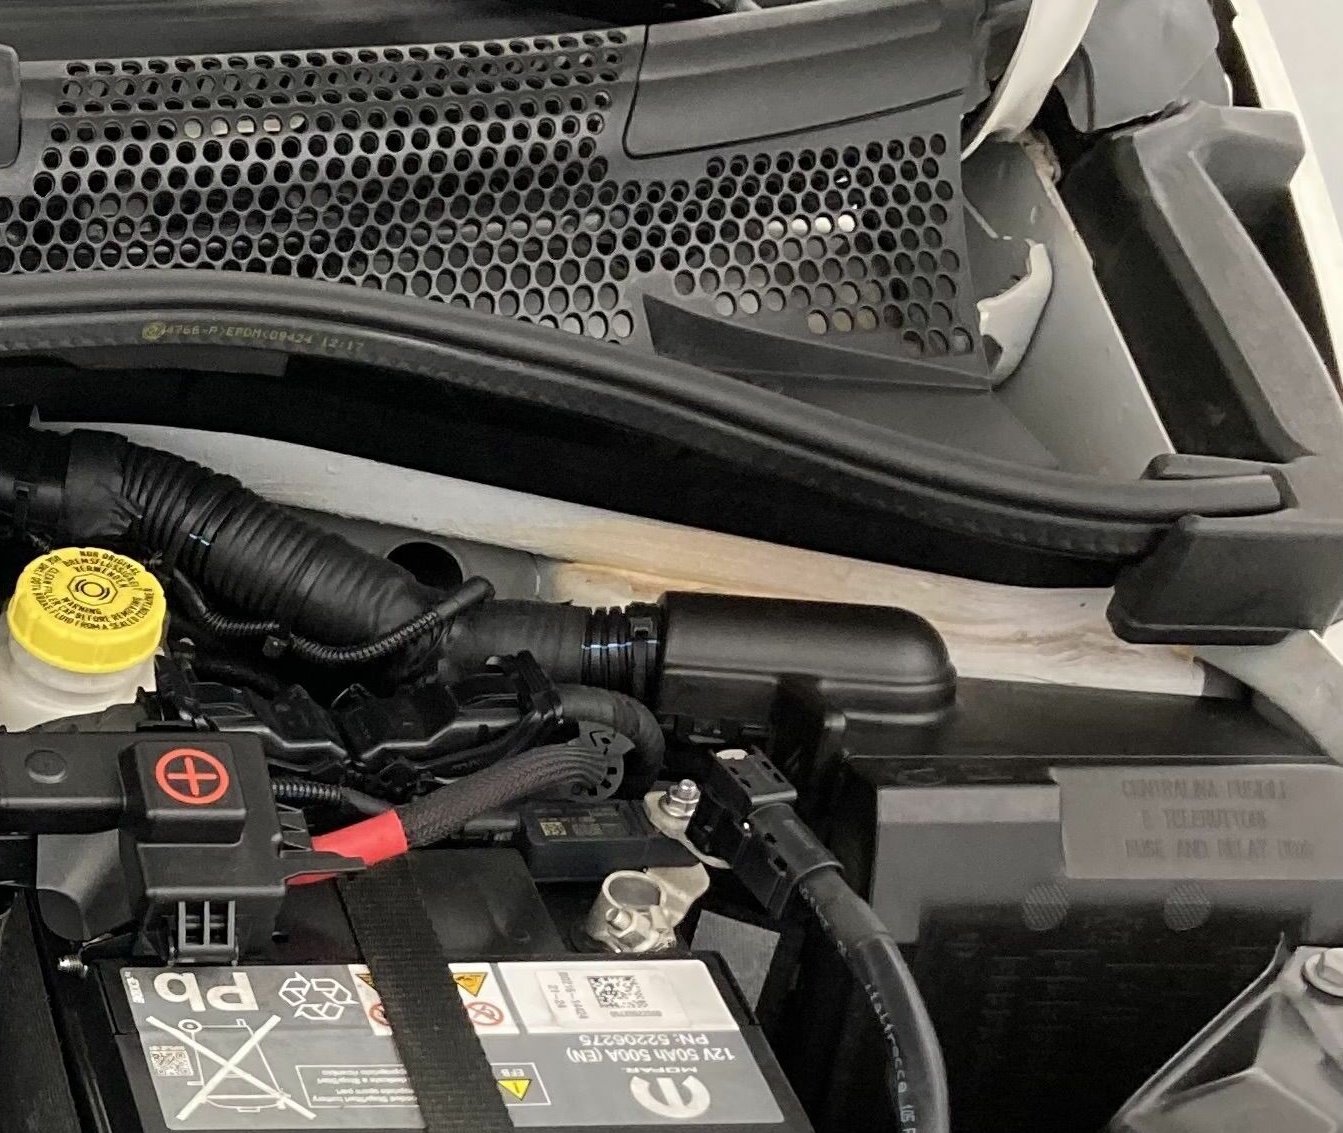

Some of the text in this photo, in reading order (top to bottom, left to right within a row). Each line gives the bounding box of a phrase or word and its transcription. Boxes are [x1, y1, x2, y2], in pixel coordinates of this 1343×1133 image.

[102, 552, 140, 576] ORIGINAL
[61, 596, 103, 615] WARNING
[153, 971, 261, 1013] Pb
[578, 1033, 710, 1046] PN: 52206275
[566, 1048, 736, 1063] 12V 50Ah 500A (EN)
[500, 1068, 525, 1077] EFB
